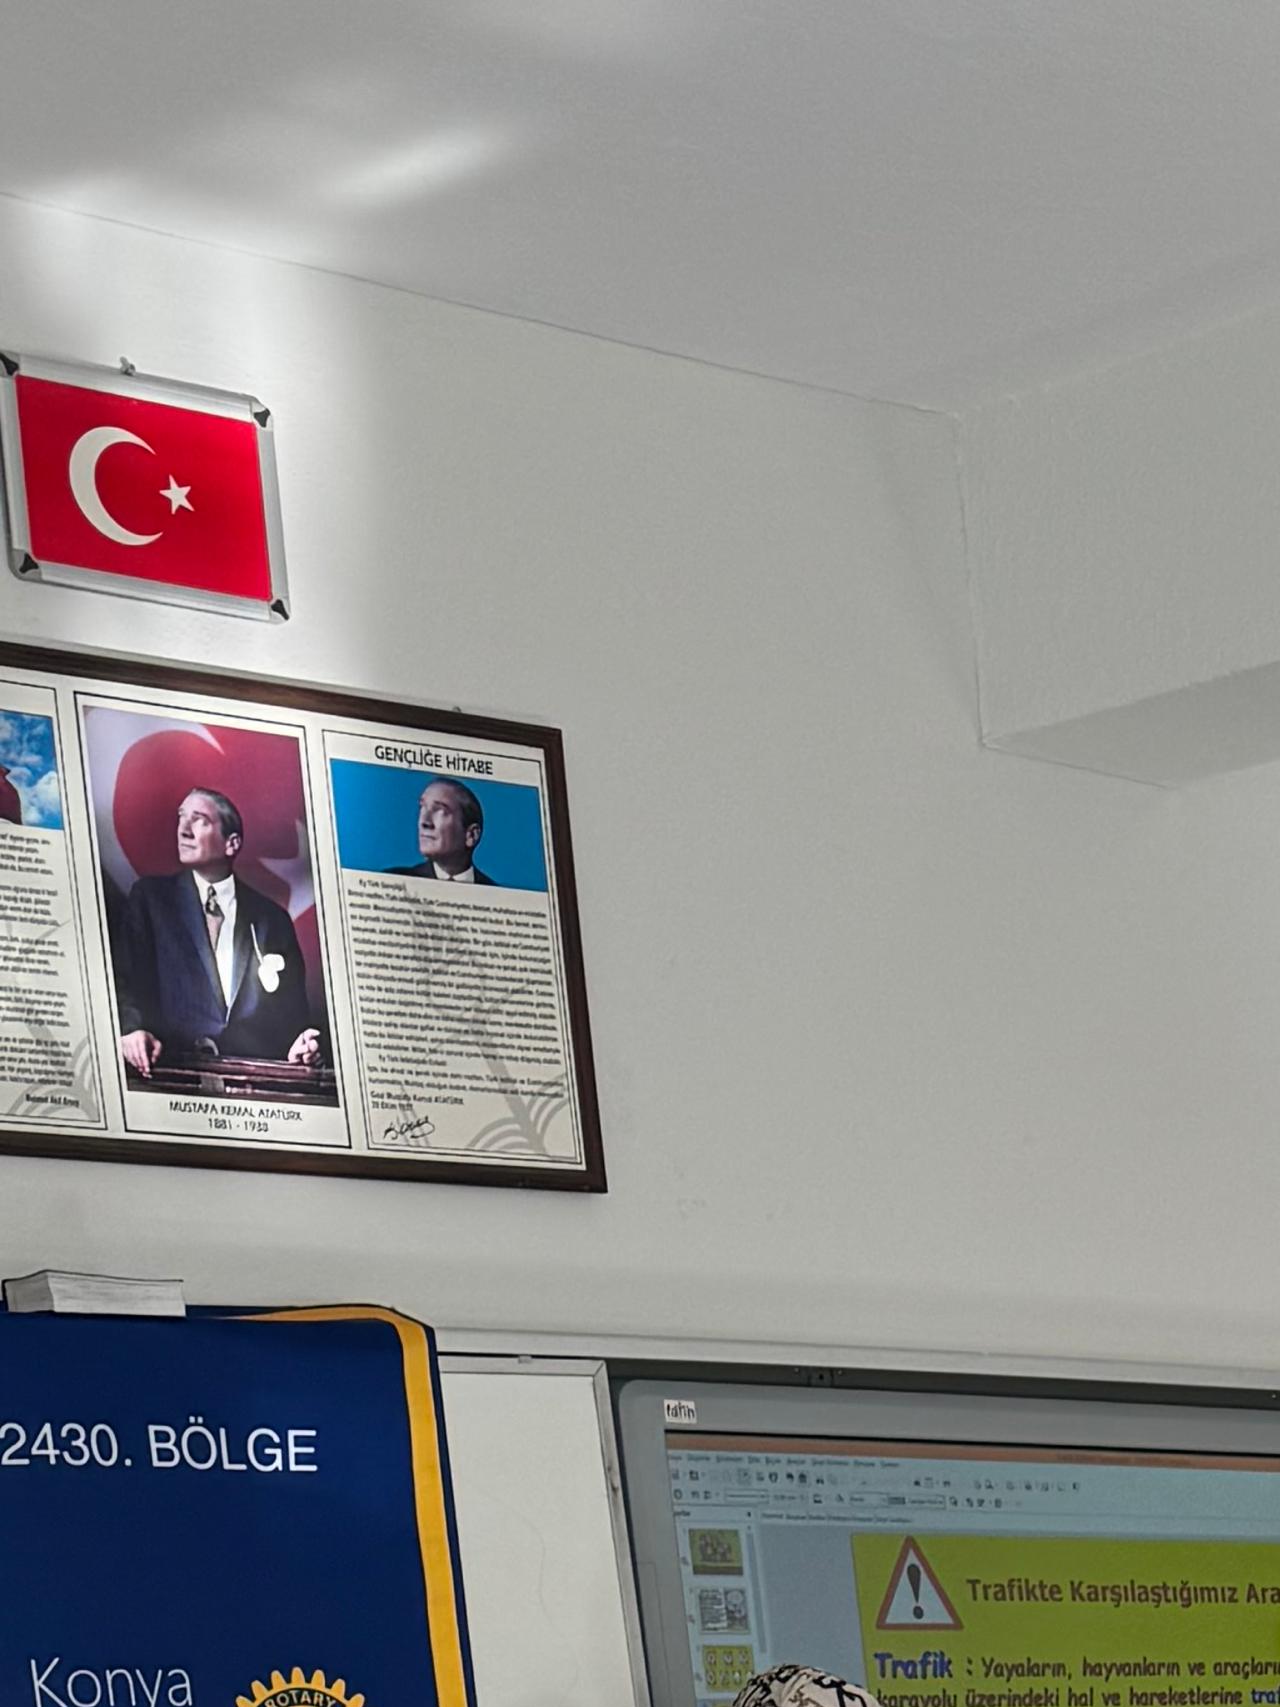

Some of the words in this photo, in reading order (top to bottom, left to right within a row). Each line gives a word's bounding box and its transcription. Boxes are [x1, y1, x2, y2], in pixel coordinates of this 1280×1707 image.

[148, 1415, 318, 1472] BÖLGE
[966, 1578, 1063, 1602] Trafikte
[1070, 1579, 1239, 1608] Karşılaştığımız
[874, 1652, 953, 1680] Trafik
[982, 1656, 1073, 1680] Yayaların,
[1082, 1656, 1181, 1682] hayvanların
[1187, 1660, 1206, 1677] ve
[1067, 1687, 1094, 1707] hal
[1101, 1692, 1121, 1707] ve
[1128, 1686, 1243, 1707] hareketlerine
